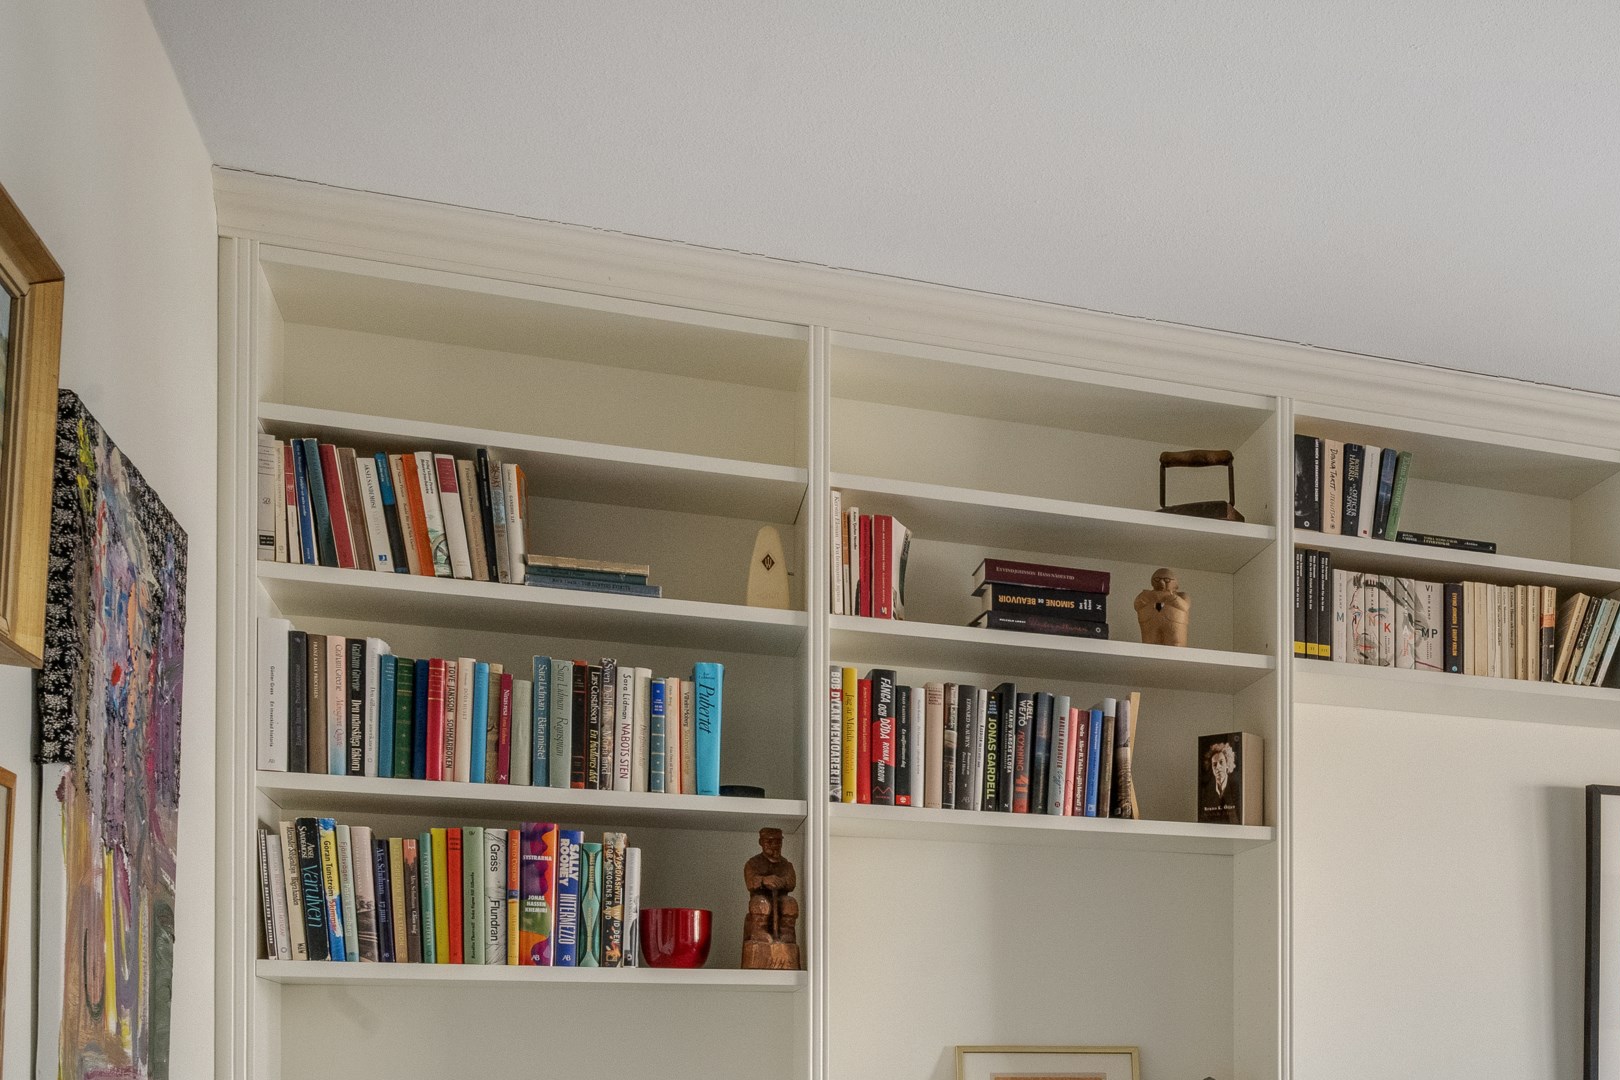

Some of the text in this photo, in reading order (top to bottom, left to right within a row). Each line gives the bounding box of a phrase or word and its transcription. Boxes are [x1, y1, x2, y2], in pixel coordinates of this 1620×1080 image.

[1330, 449, 1338, 469] DONNA
[999, 595, 1075, 608] SIMONE BEAUVOIR
[351, 643, 362, 692] Graham Greene
[603, 663, 613, 682] Sven
[880, 677, 892, 702] FÅNGA
[445, 666, 456, 769] TOVE JANSSON SOMMARBOKEN
[537, 664, 547, 760] Sara Lidman Bära mistel
[590, 671, 599, 739] Lars Gustafsson En
[619, 674, 632, 779] Sara Lidman NABOTS STEN
[698, 683, 716, 734] Pubertet
[831, 672, 840, 775] BOB DYLAN MEMOARER
[878, 704, 887, 716] OCH
[880, 718, 891, 739] DÖDA
[1018, 700, 1027, 726] WESTÖ
[352, 699, 362, 771] Den faktorn
[987, 717, 997, 799] JONAS GARDELL
[877, 760, 885, 782] FARROW
[1016, 730, 1029, 793] SKYMNING 41
[298, 825, 307, 859] SANDEMOSE
[559, 838, 579, 886] SALLY ROONEY
[324, 840, 334, 897] Göran Tunström
[490, 844, 500, 941] Grass Flundran
[303, 864, 323, 928] Varulven
[558, 893, 576, 944] INTERMEZZO
